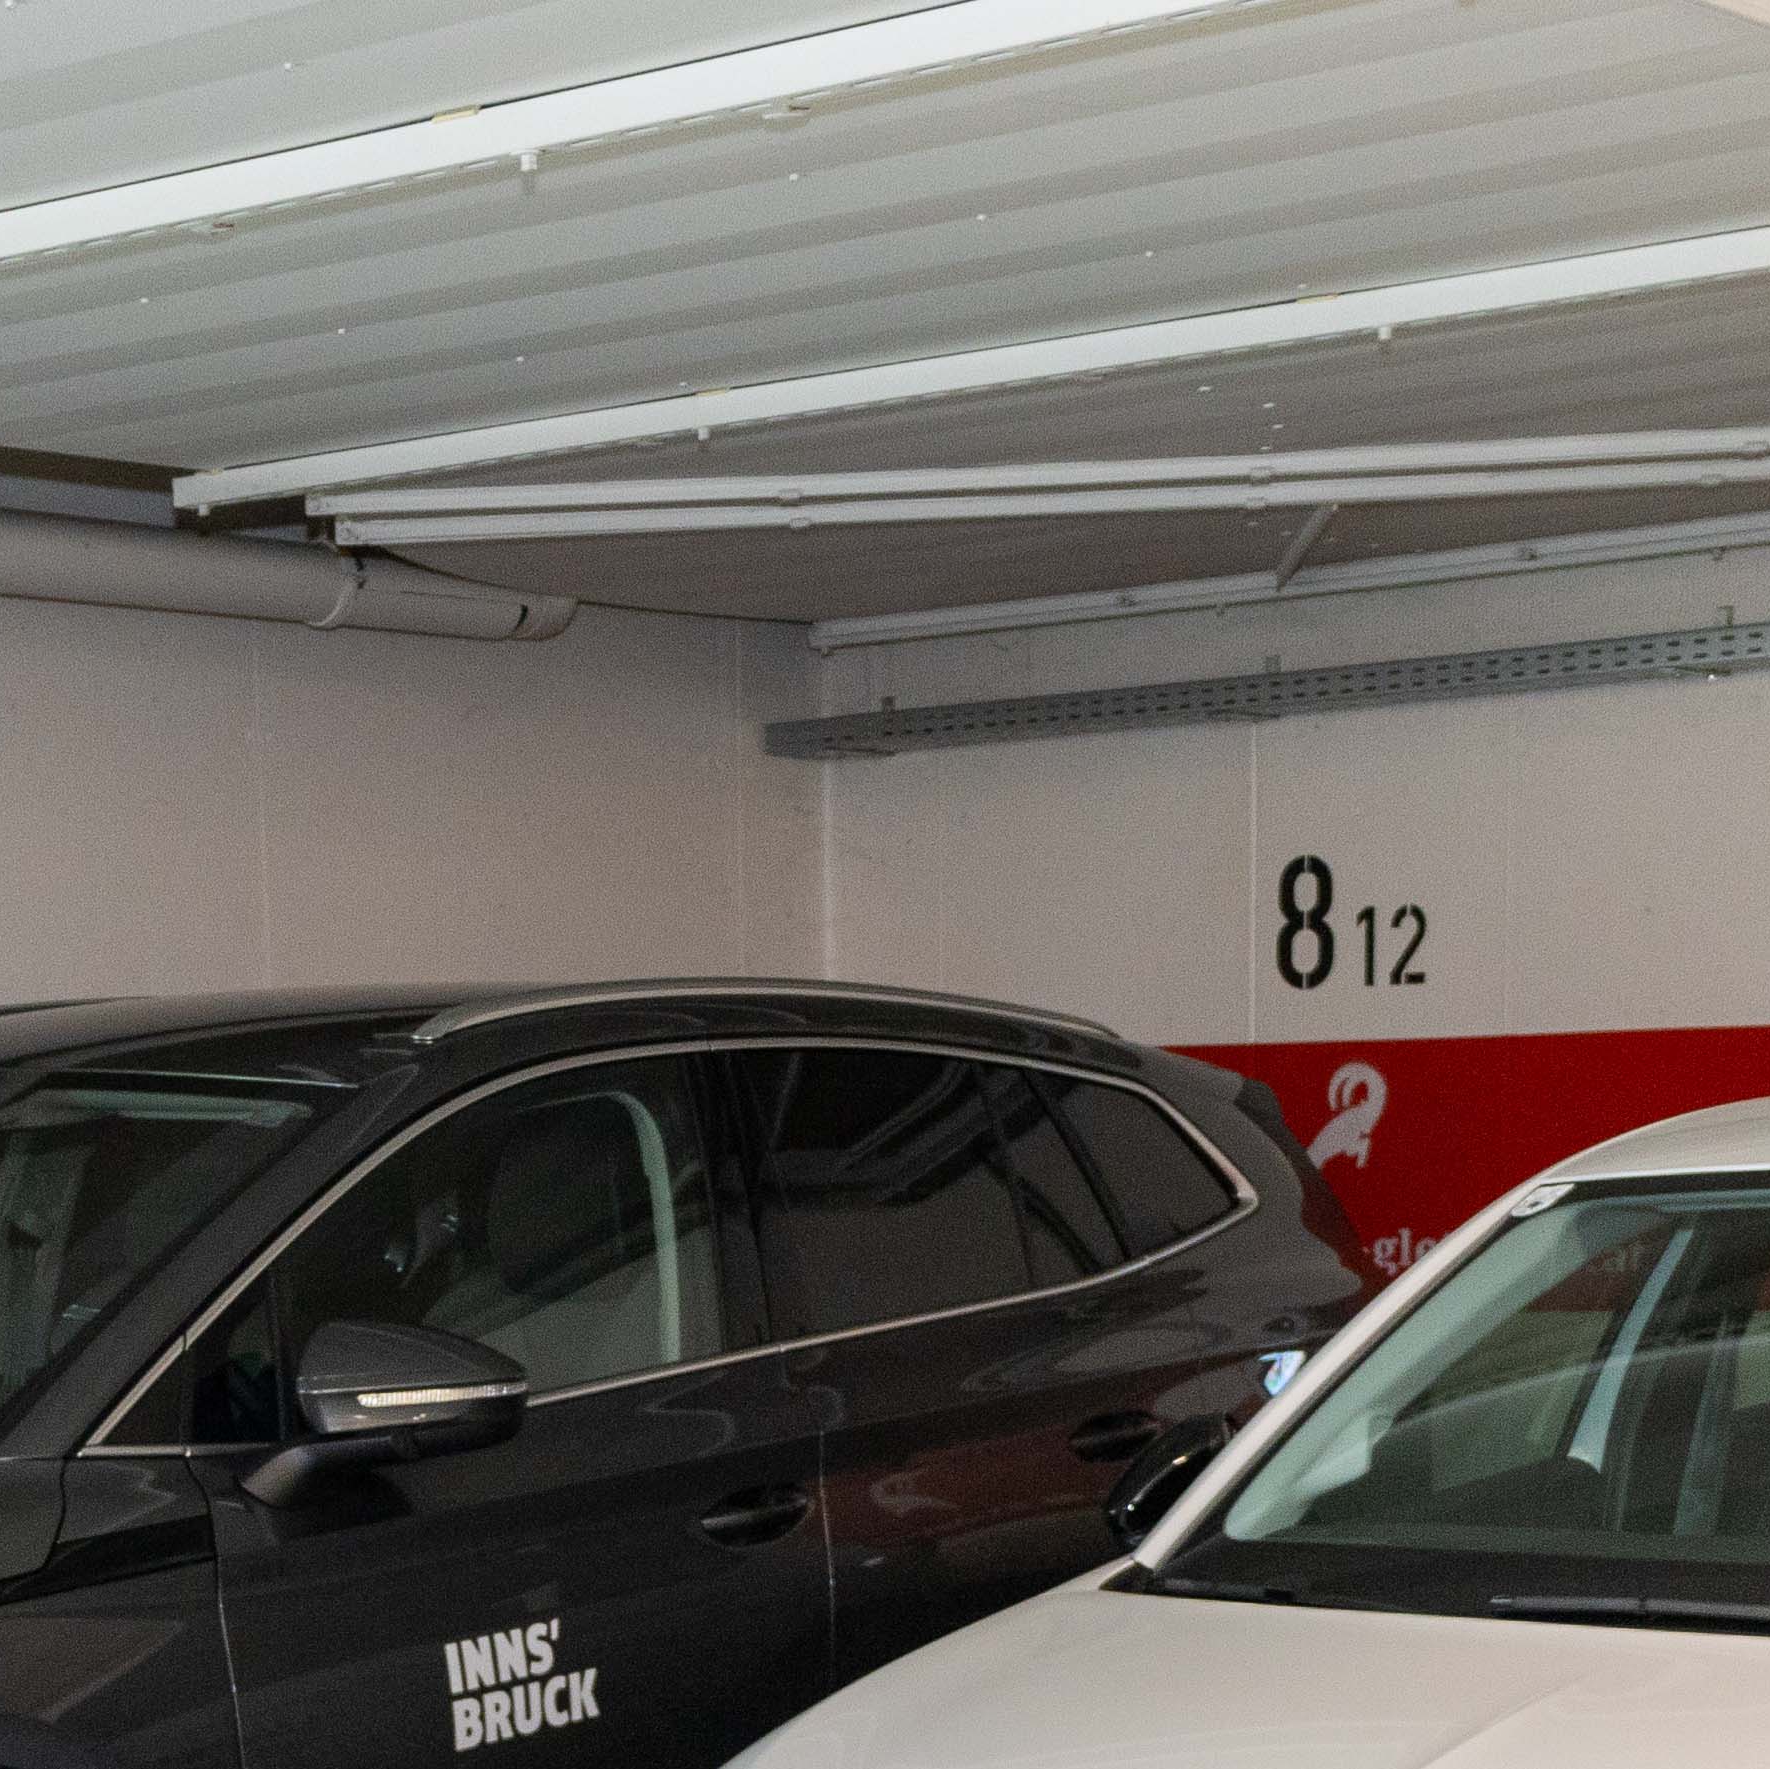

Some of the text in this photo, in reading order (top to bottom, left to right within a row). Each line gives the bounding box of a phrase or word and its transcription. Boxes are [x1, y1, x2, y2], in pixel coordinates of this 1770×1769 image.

[1276, 854, 1427, 990] 8 12
[452, 1667, 600, 1752] BRUCK
